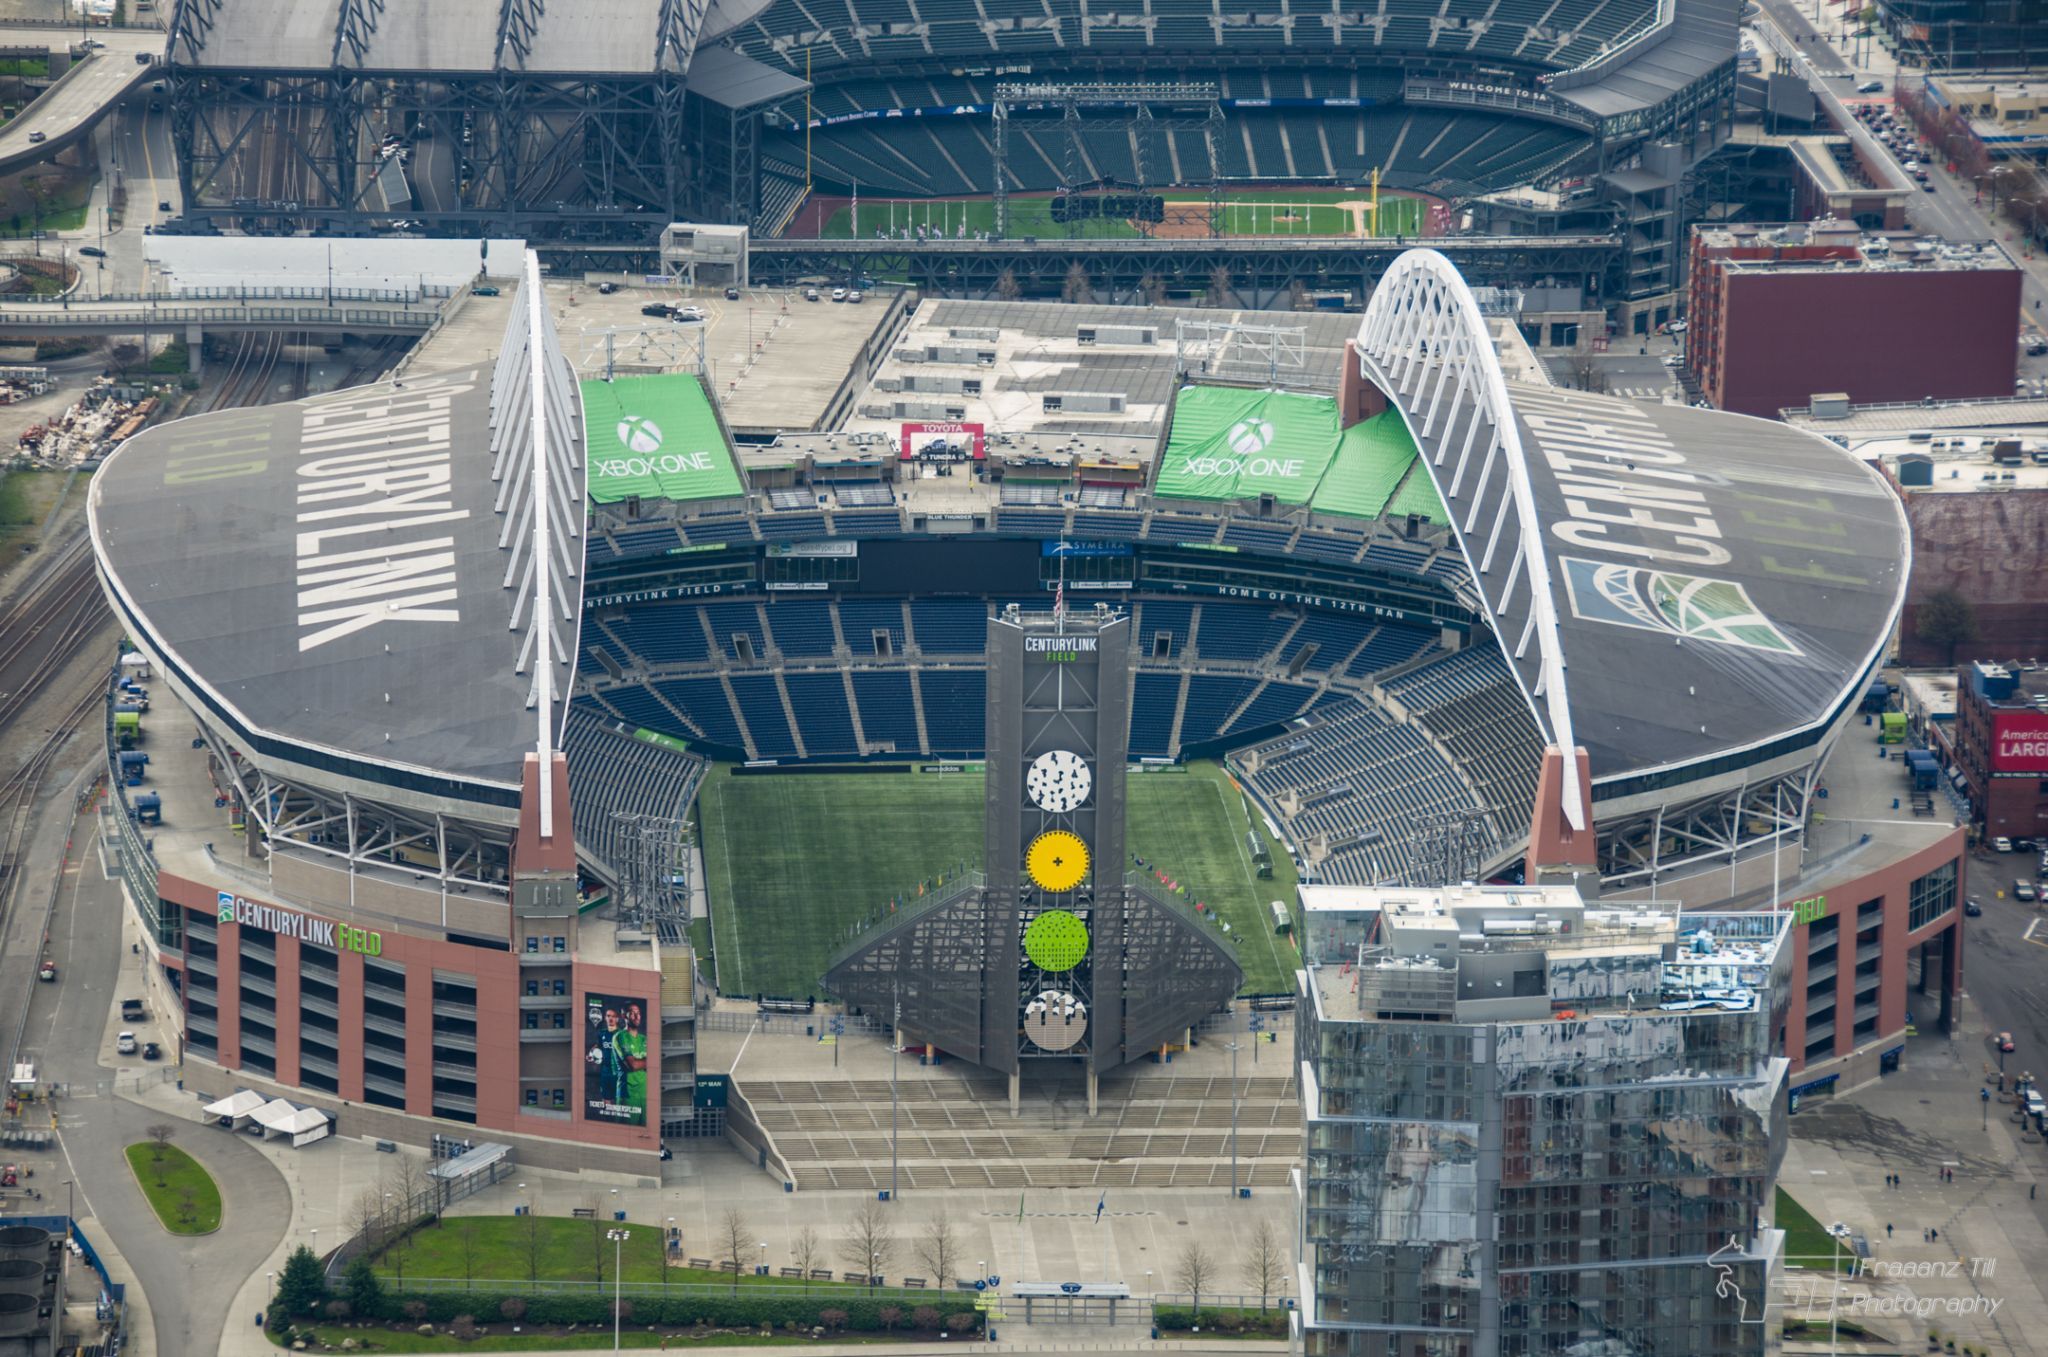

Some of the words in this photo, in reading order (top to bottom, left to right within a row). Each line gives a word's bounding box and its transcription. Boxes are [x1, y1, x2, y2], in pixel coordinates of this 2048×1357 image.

[1449, 82, 1511, 95] WELCOME
[1516, 88, 1529, 97] TO
[921, 424, 963, 433] TOYOTA
[593, 456, 662, 477] XBOX
[660, 451, 715, 474] ONE
[1180, 457, 1249, 477] XBOX
[1249, 458, 1305, 477] ONE
[1073, 542, 1125, 550] SYMETRA
[678, 584, 722, 597] FIELD
[1218, 586, 1259, 598] HOME
[1269, 591, 1286, 601] OF
[1296, 595, 1322, 606] THE
[1331, 600, 1366, 613] 12TH
[1375, 607, 1405, 619] MAN
[1025, 637, 1097, 652] CENTURYLINK
[1046, 651, 1077, 662] FIELD
[2000, 742, 2048, 757] LARG
[1792, 895, 1826, 929] FIELD
[235, 897, 335, 947] CENTURYLINK
[337, 922, 383, 957] FIELD
